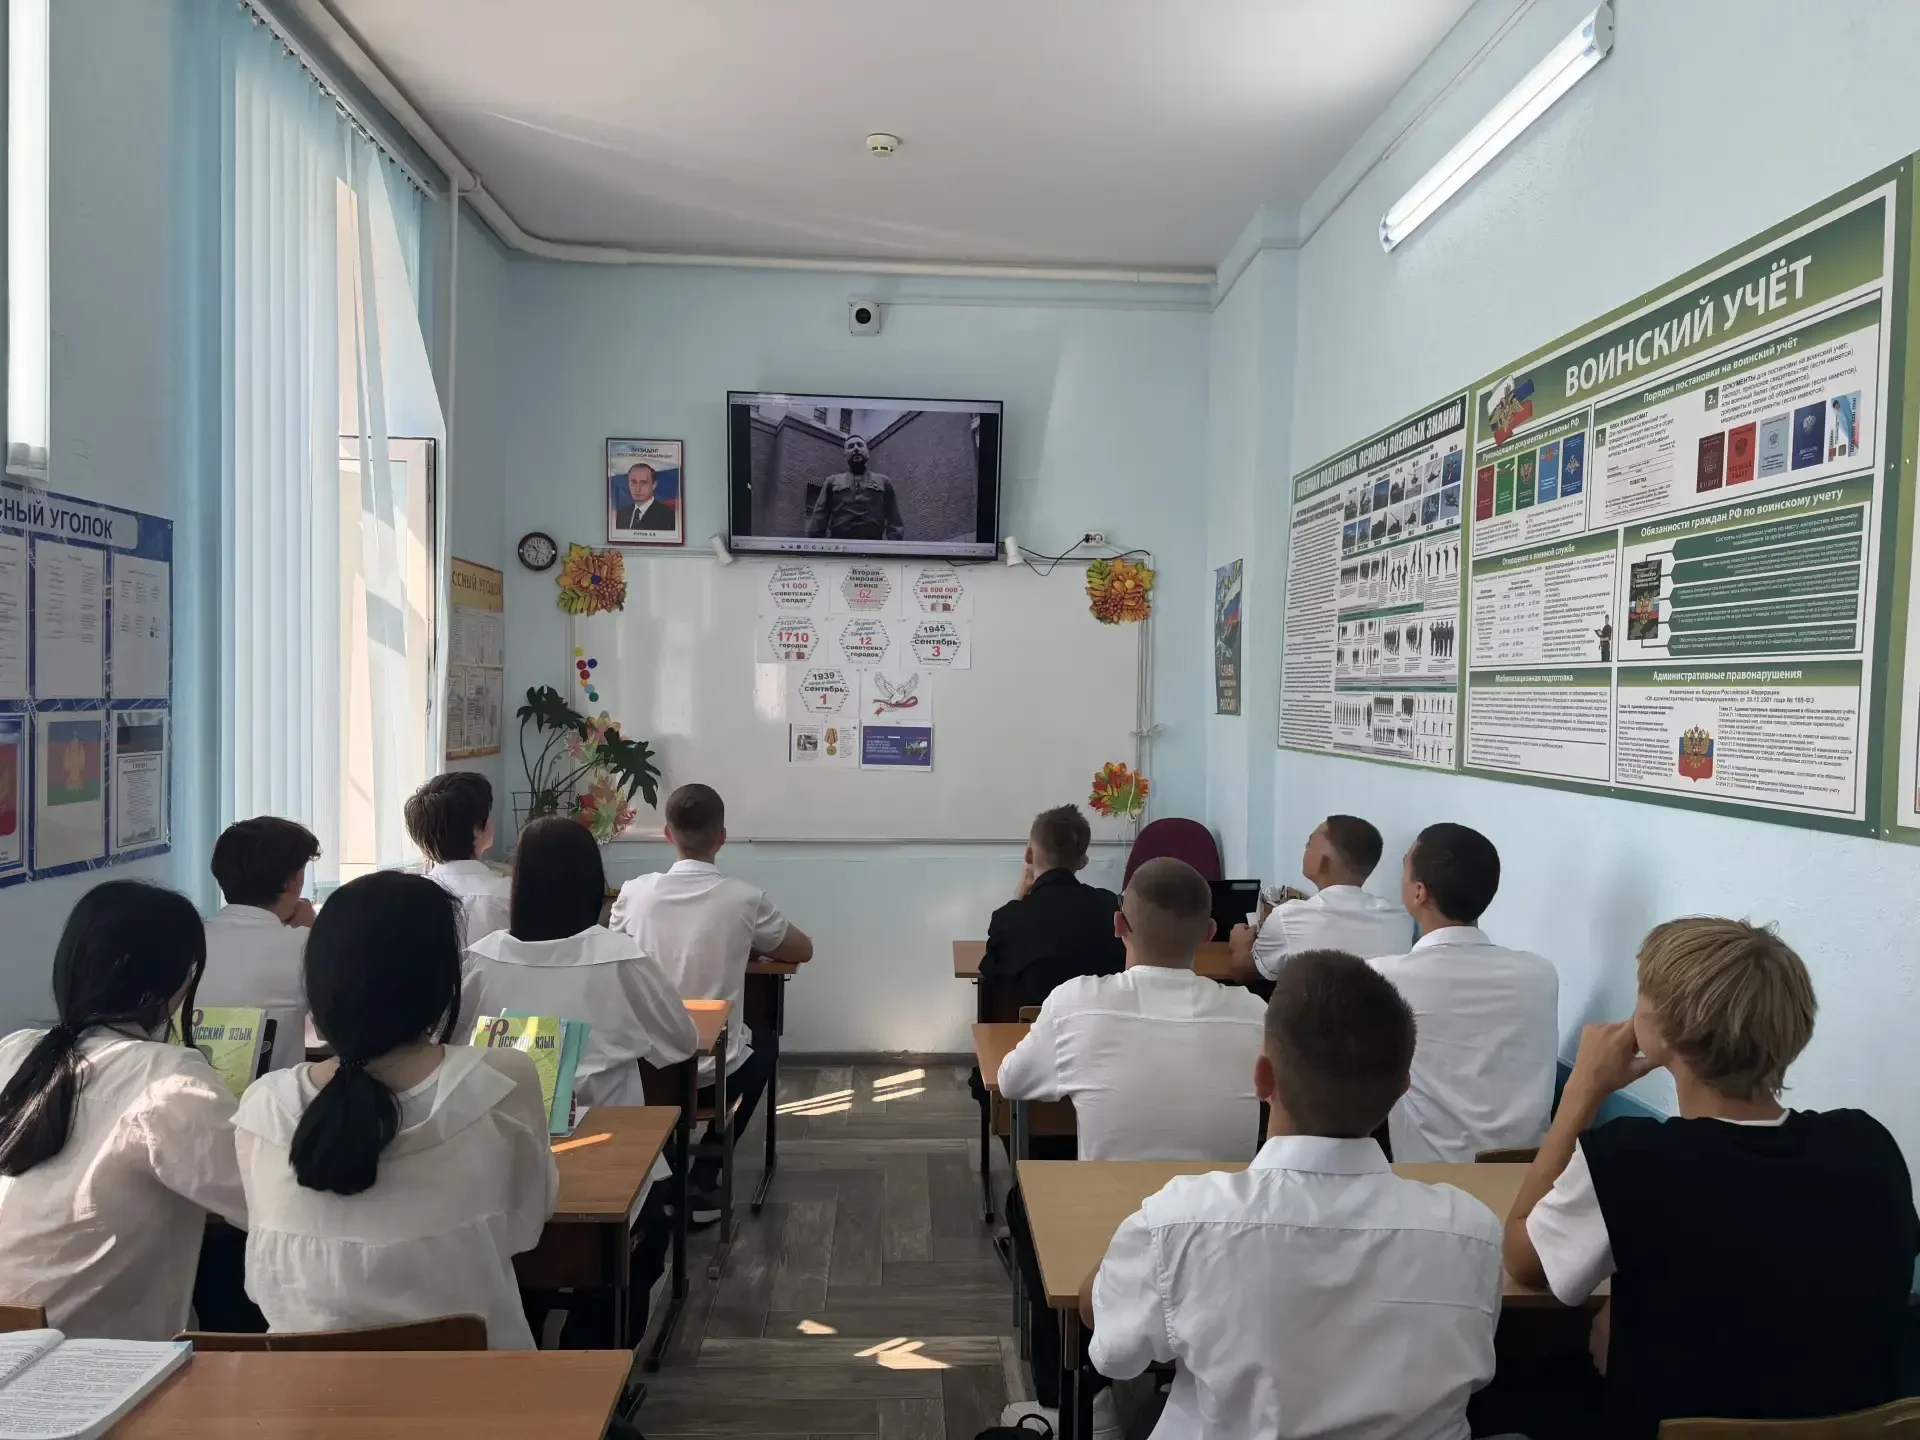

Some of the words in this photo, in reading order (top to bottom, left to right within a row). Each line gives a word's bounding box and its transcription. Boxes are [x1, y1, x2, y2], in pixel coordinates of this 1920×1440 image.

[1565, 296, 1715, 397] ВОИНСКИЙ
[1723, 255, 1812, 331] УЧЁТ
[1643, 388, 1674, 403] Порядок
[1675, 367, 1721, 391] постановки
[1721, 364, 1731, 374] на
[1733, 345, 1775, 370] воинский
[1776, 337, 1798, 356] учёт
[1722, 375, 1756, 392] ДОКУМЕНТЫ
[1806, 348, 1832, 362] воинский
[1708, 394, 1716, 405] 2.
[1359, 438, 1389, 469] ОСНОВЫ
[1389, 420, 1426, 456] ВОЕННЫХ
[1426, 400, 1462, 438] ЗНАНИЙ
[1515, 434, 1544, 450] документы
[1549, 423, 1570, 437] законы
[1570, 417, 1580, 428] РФ
[1641, 520, 1690, 537] Обязанности
[1691, 512, 1727, 530] граждан
[1728, 508, 1742, 521] РФ
[1743, 506, 1755, 517] по
[1757, 494, 1811, 514] воинскому
[1812, 488, 1844, 507] учету
[0, 498, 44, 527] НЫЙ
[49, 507, 113, 540] УГОЛОК
[1502, 553, 1528, 566] Отношение
[1533, 548, 1554, 561] военной
[1555, 543, 1575, 558] службе
[851, 568, 881, 576] Вторая
[859, 588, 872, 599] 62
[923, 624, 946, 634] 1945
[777, 631, 809, 643] 1710
[859, 636, 872, 645] 12
[914, 638, 958, 647] сентябрь
[932, 646, 941, 657] 3
[812, 671, 835, 681] 1939
[1495, 674, 1541, 683] Мобилизационная
[1541, 674, 1574, 683] подготовка
[1652, 670, 1725, 682] Административные
[1726, 669, 1802, 682] правонарушения
[804, 685, 844, 693] сентябрь
[1751, 689, 1780, 697] Федерации
[819, 693, 827, 705] 1
[229, 1027, 253, 1041] язык
[535, 1036, 555, 1050] язык
